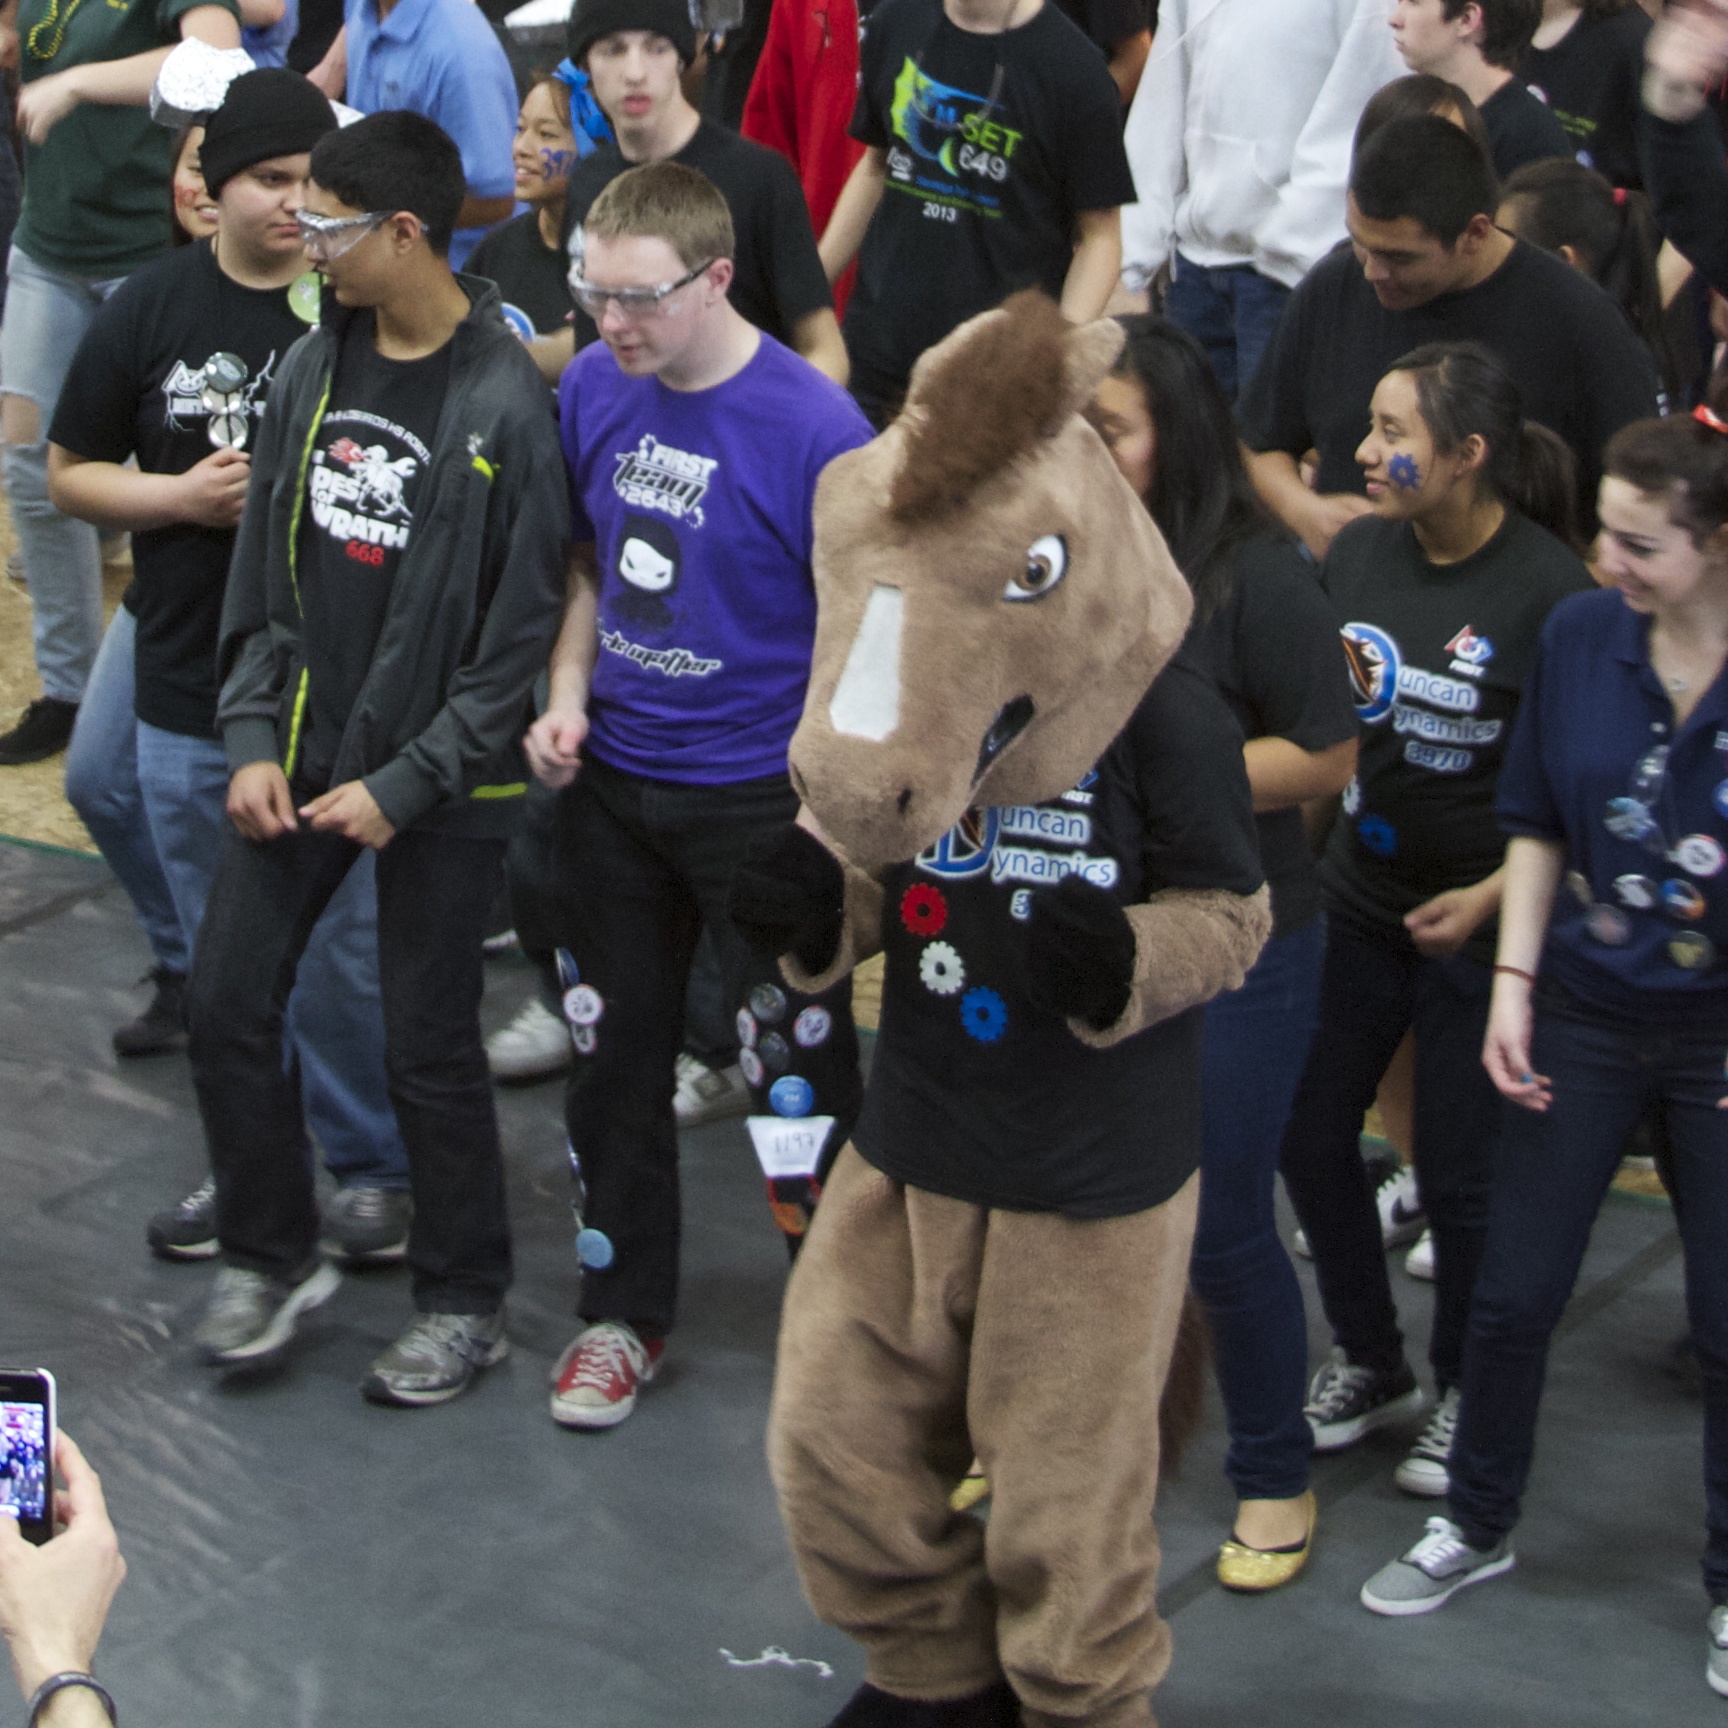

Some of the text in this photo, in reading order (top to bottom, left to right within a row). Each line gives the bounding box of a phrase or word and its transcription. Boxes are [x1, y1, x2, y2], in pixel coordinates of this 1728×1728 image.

[959, 143, 1007, 181] 649
[923, 201, 958, 222] 2013
[651, 444, 719, 481] FIRST
[313, 465, 362, 502] PES
[311, 502, 411, 549] WRATH
[345, 540, 386, 566] 668
